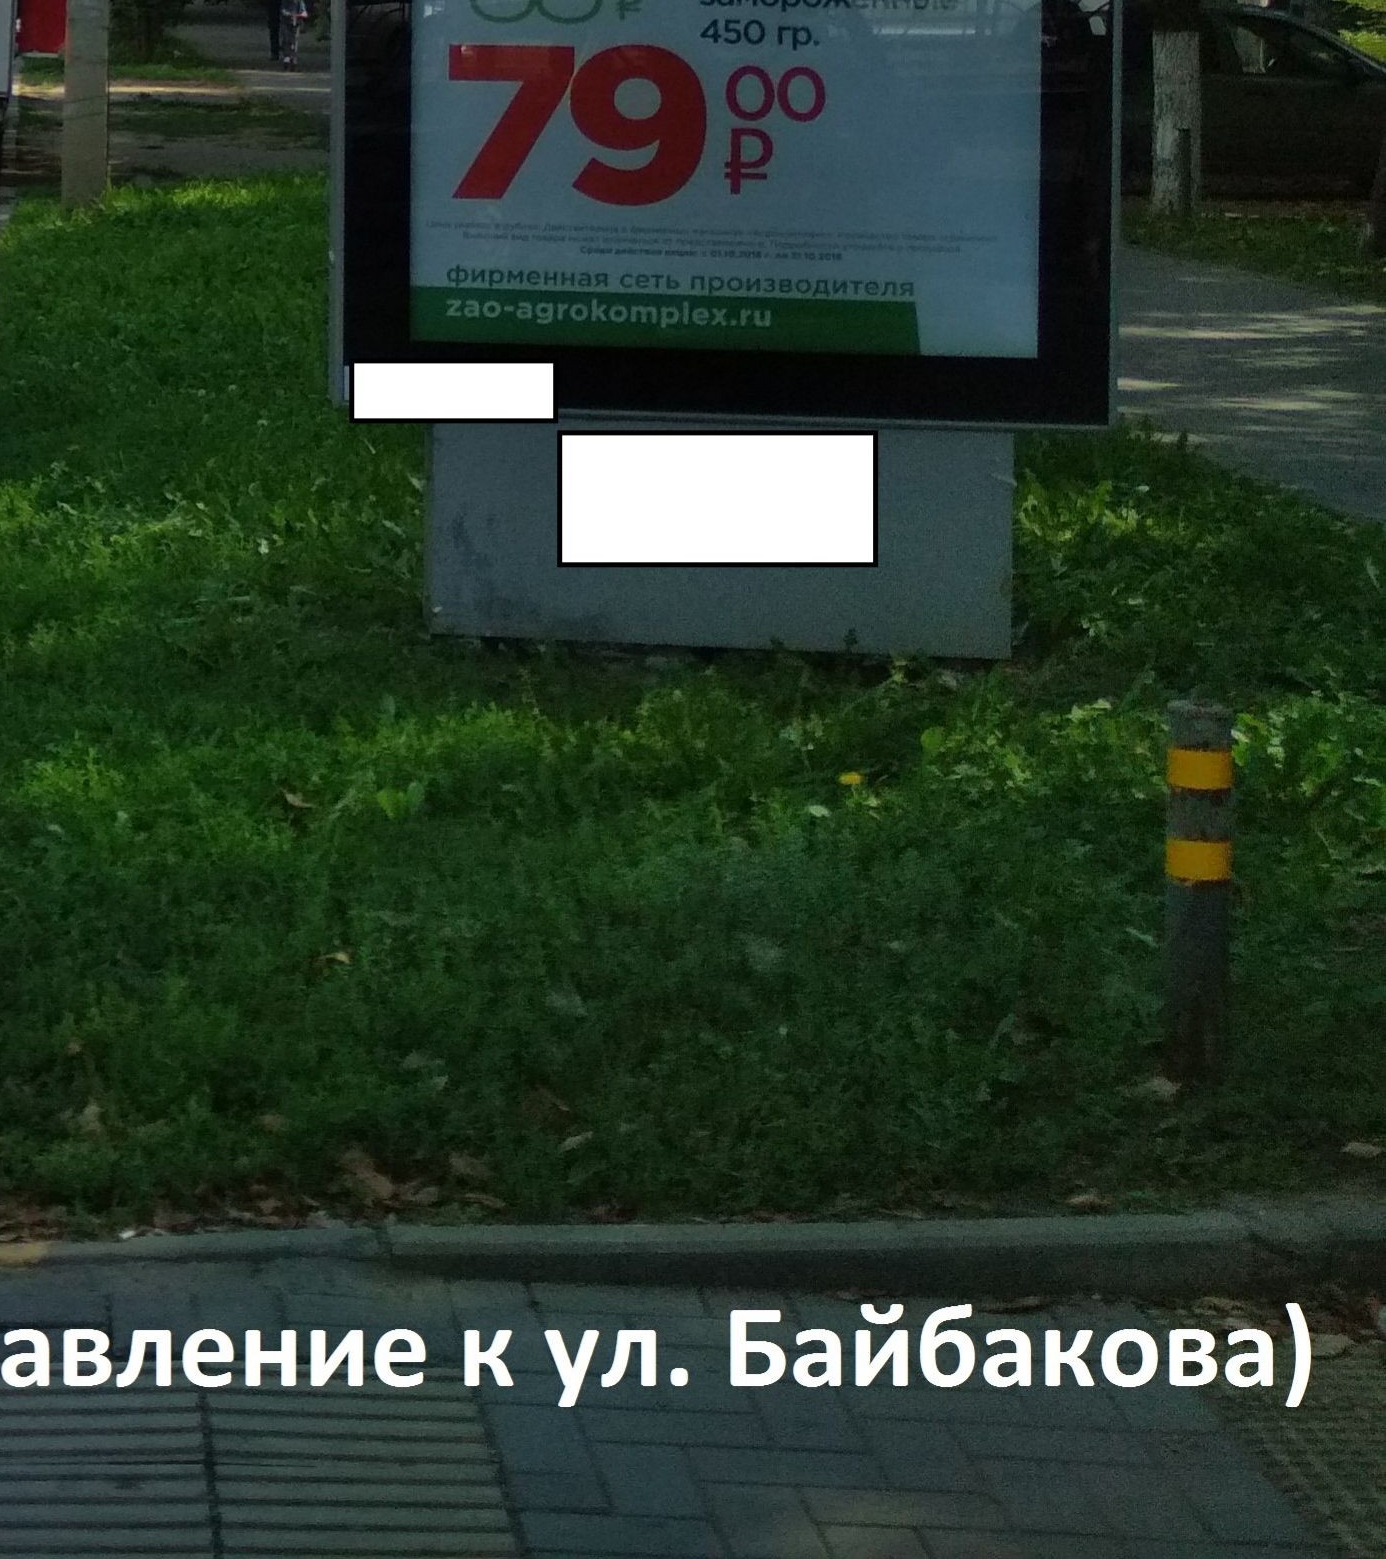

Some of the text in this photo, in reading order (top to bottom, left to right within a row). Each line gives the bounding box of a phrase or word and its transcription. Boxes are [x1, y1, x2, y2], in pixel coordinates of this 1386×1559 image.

[700, 19, 821, 51] 450 гр.
[448, 44, 827, 207] 79 00
[446, 264, 915, 298] фирменная сеть производителя
[445, 298, 772, 329] zao-agrokomplex.ru
